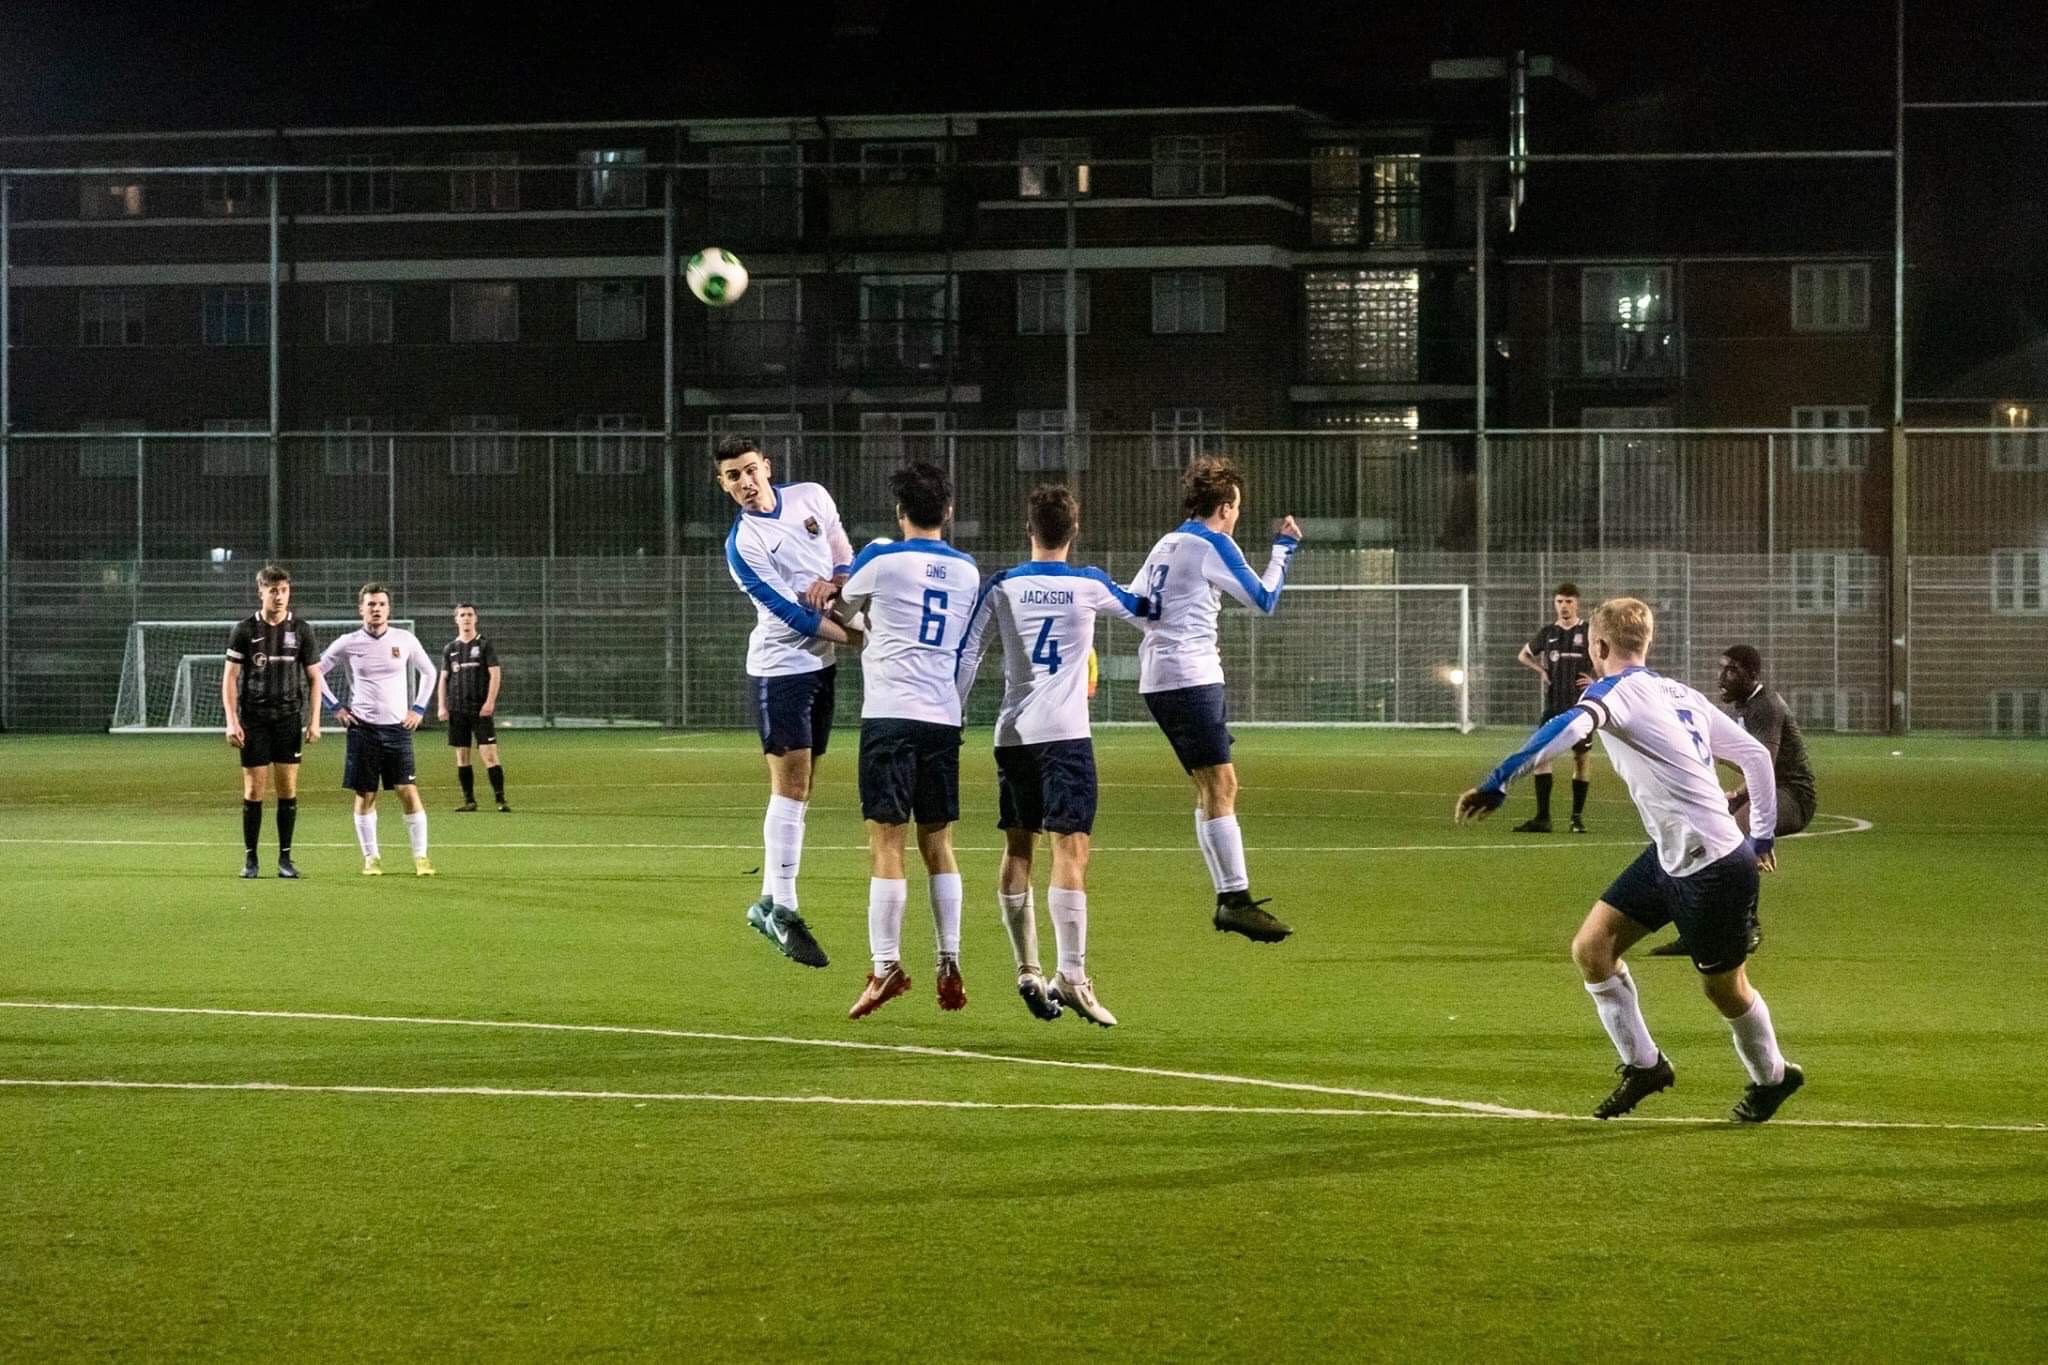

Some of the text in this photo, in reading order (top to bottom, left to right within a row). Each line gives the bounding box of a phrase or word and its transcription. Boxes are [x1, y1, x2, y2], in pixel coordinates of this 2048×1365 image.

[926, 564, 946, 579] ONG
[1020, 590, 1074, 605] JACKSON
[918, 588, 948, 647] 6
[1032, 616, 1063, 676] 4
